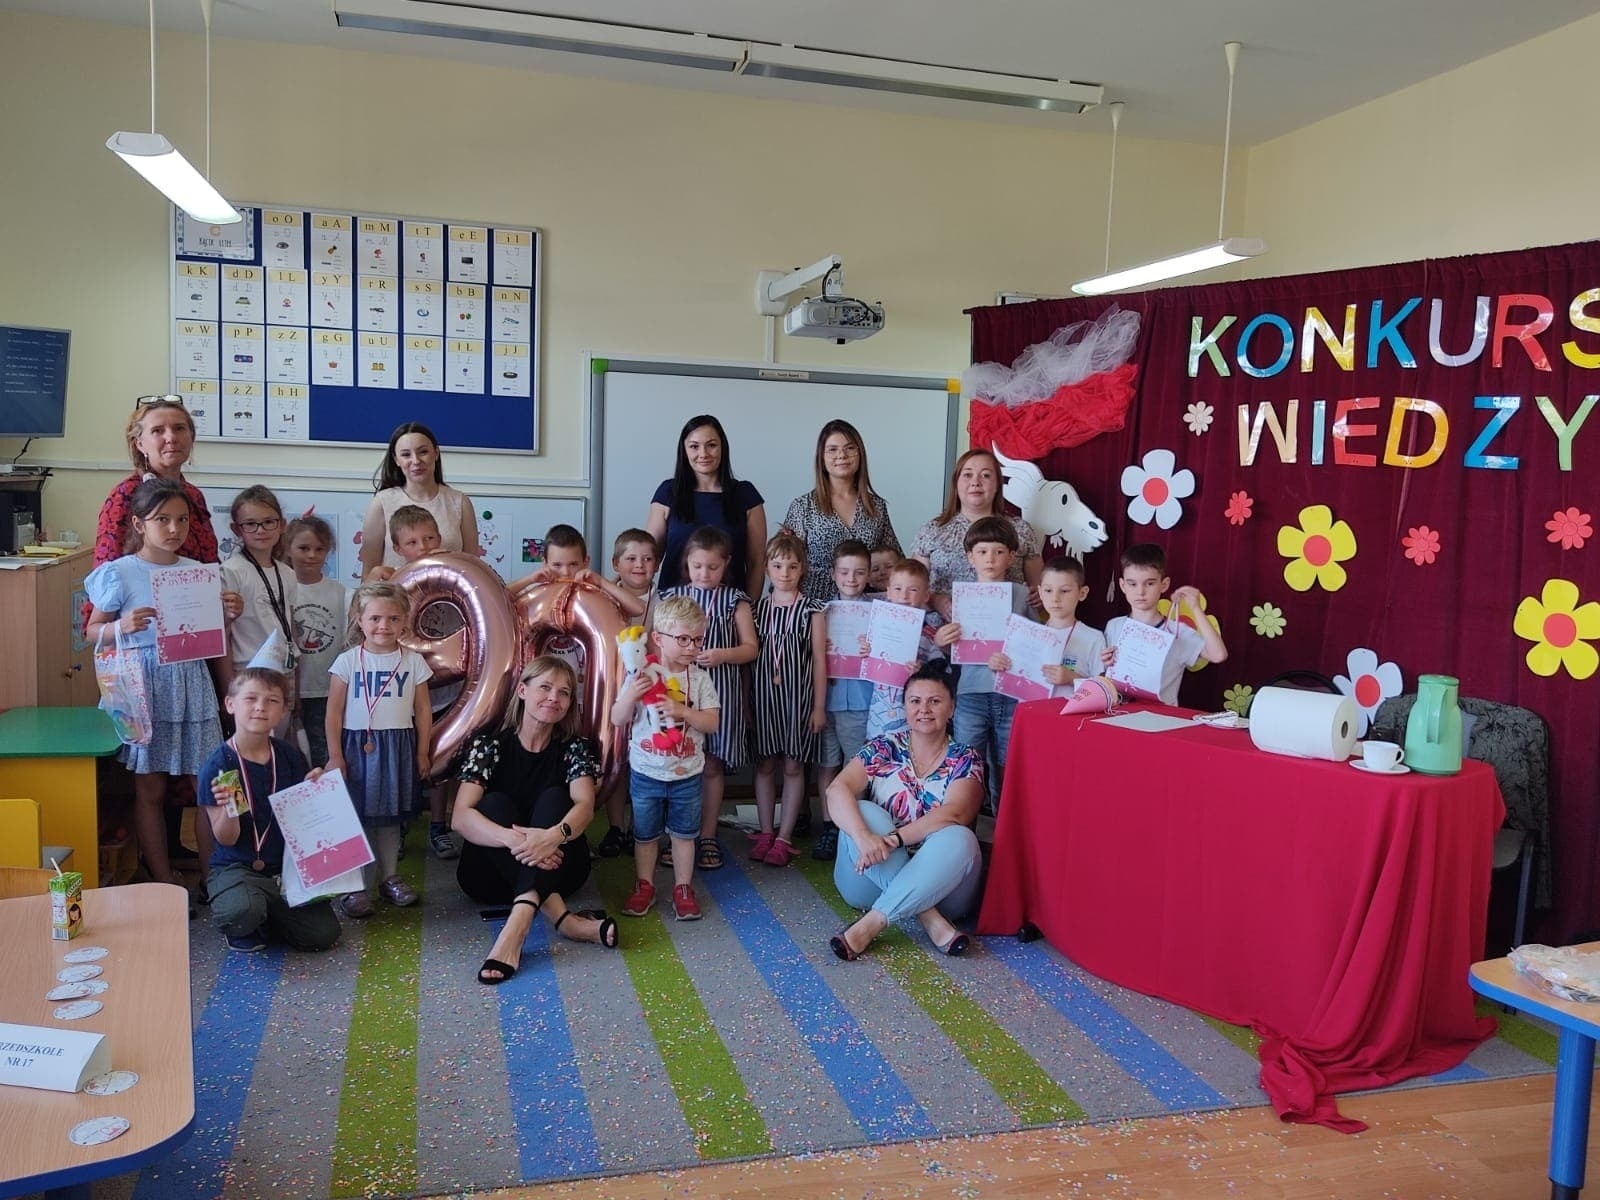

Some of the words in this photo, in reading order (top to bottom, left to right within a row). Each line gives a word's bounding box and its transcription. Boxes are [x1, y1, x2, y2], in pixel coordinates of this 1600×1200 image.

[1188, 287, 1600, 378] KONKURS
[1236, 394, 1600, 471] WIEDZY
[354, 671, 409, 698] HEY
[8, 1056, 20, 1066] NR
[22, 1058, 34, 1067] 17
